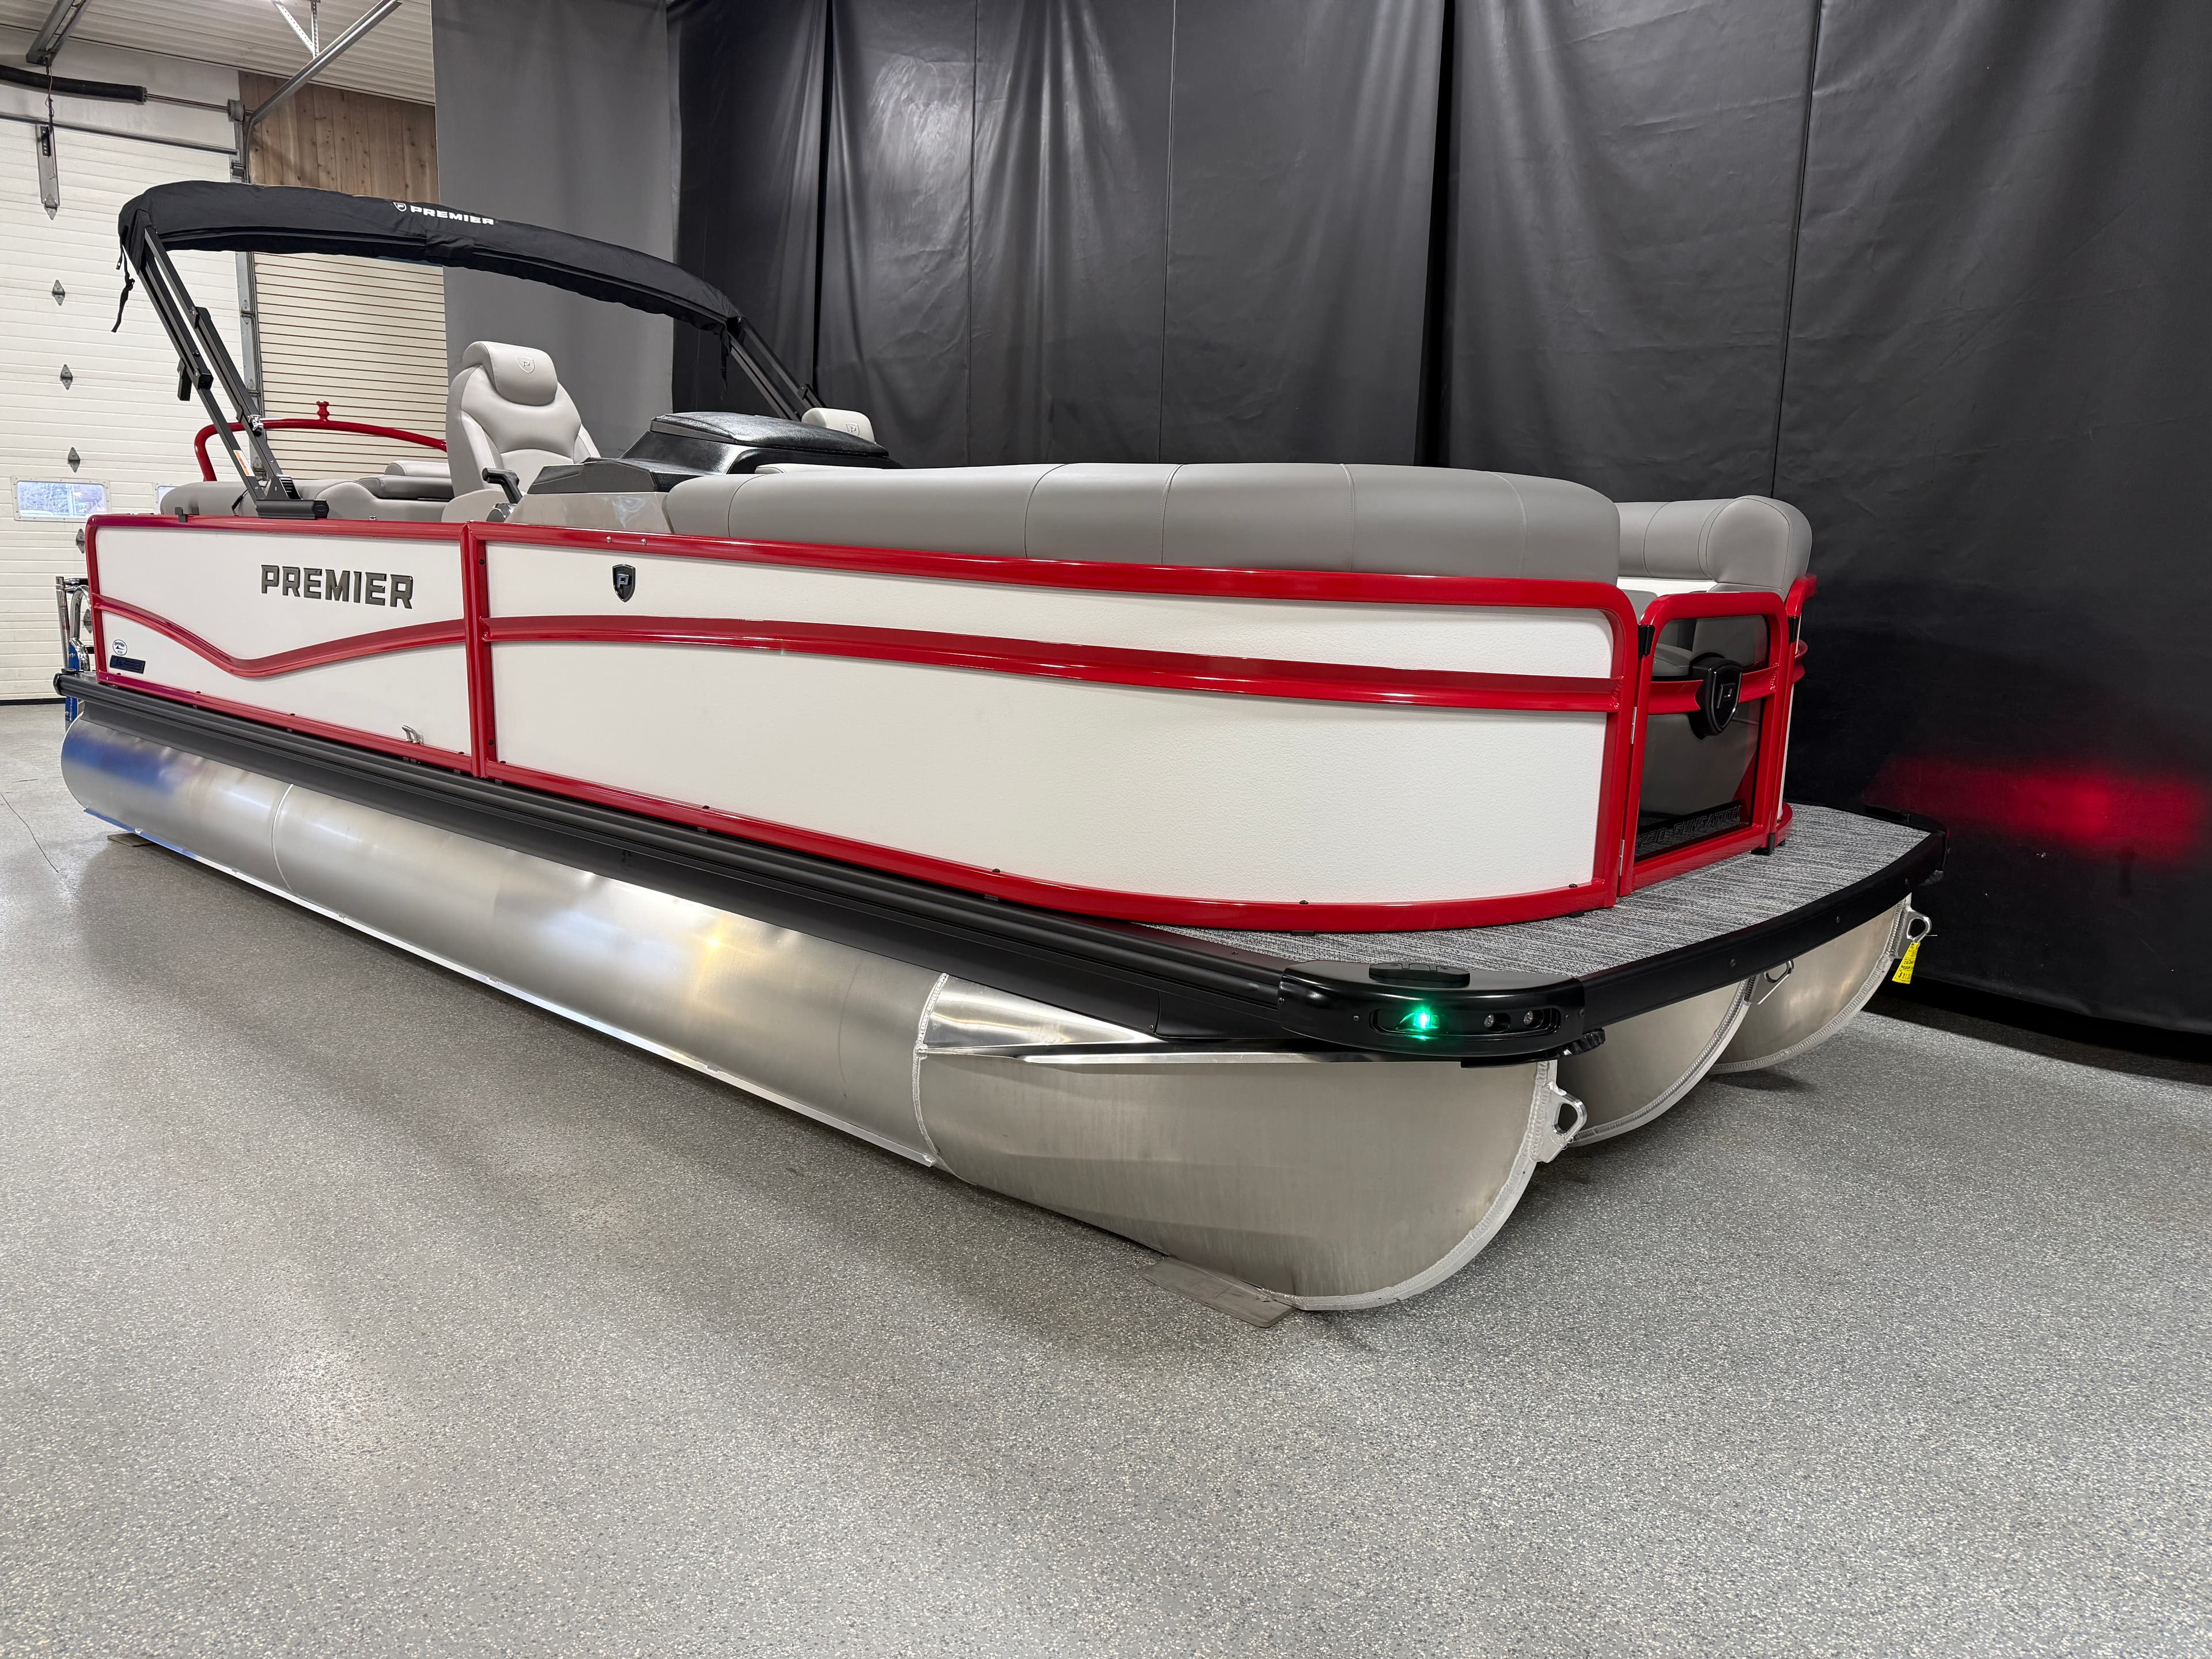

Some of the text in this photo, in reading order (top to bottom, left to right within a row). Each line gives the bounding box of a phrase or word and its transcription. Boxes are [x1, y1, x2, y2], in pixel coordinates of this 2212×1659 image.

[410, 205, 494, 225] PREMIER
[261, 565, 414, 609] PREMIER
[1673, 805, 1742, 835] SUNSATION
